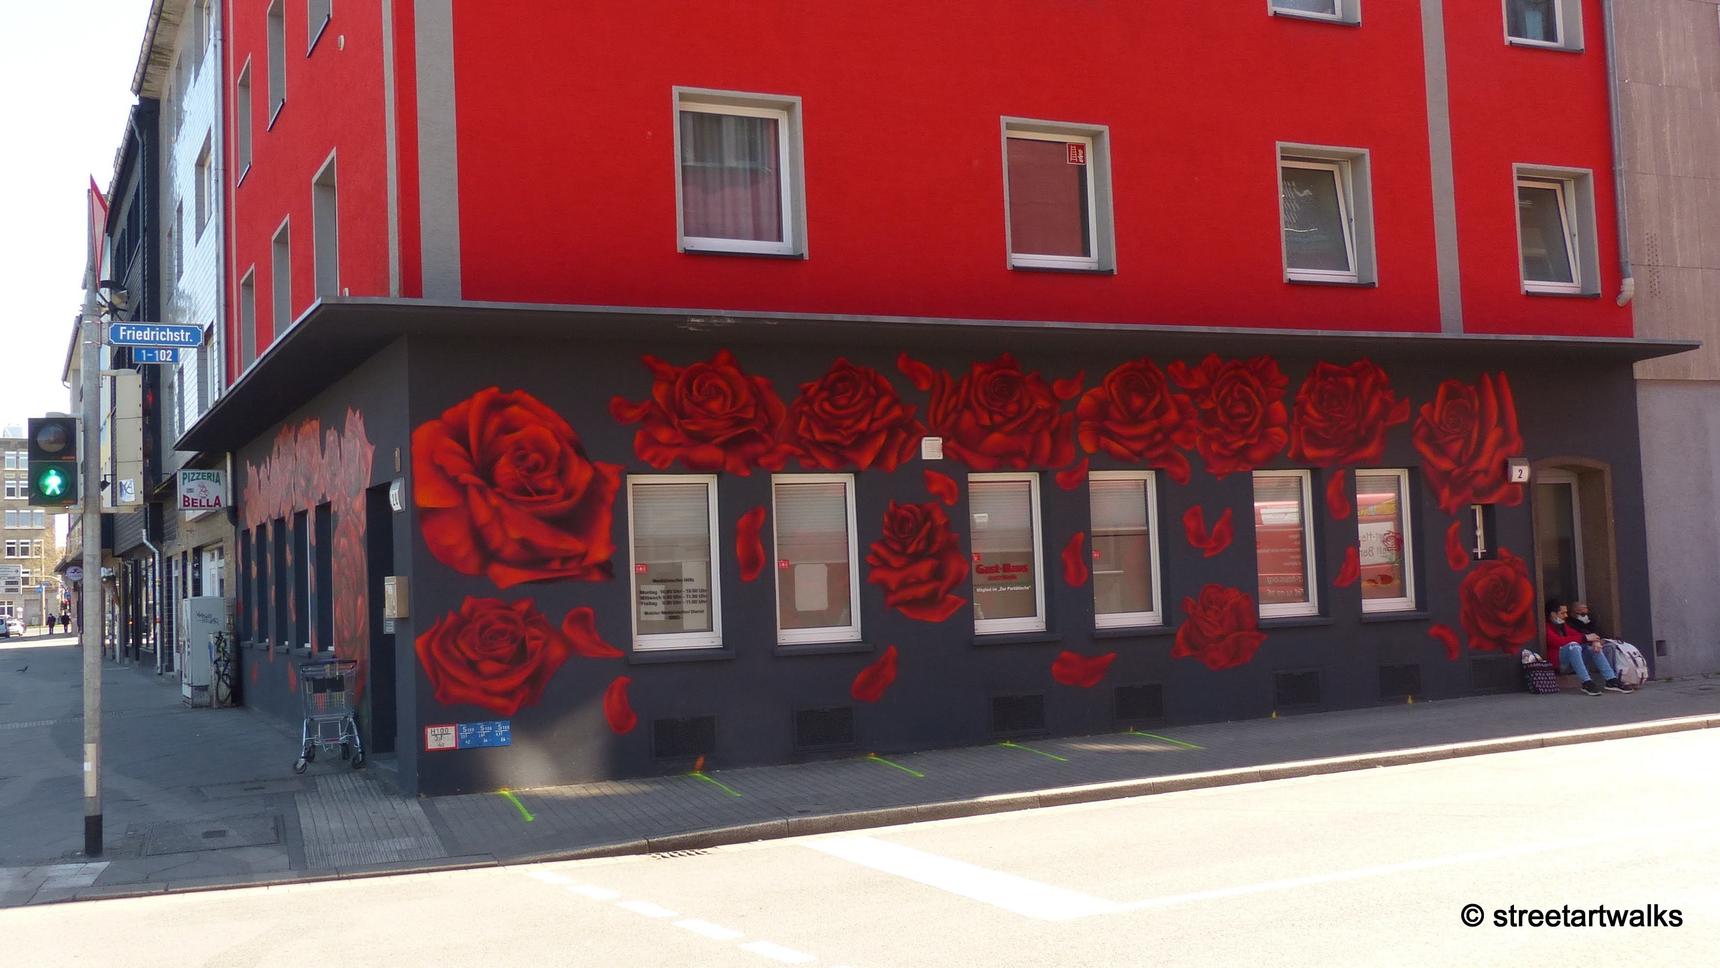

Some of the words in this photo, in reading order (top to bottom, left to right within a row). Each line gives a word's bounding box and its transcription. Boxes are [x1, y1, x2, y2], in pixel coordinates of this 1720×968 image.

[120, 326, 193, 342] Friedrichstr.
[141, 350, 172, 361] 1-102
[182, 472, 221, 485] PIZZERIA
[182, 495, 222, 507] BELLA
